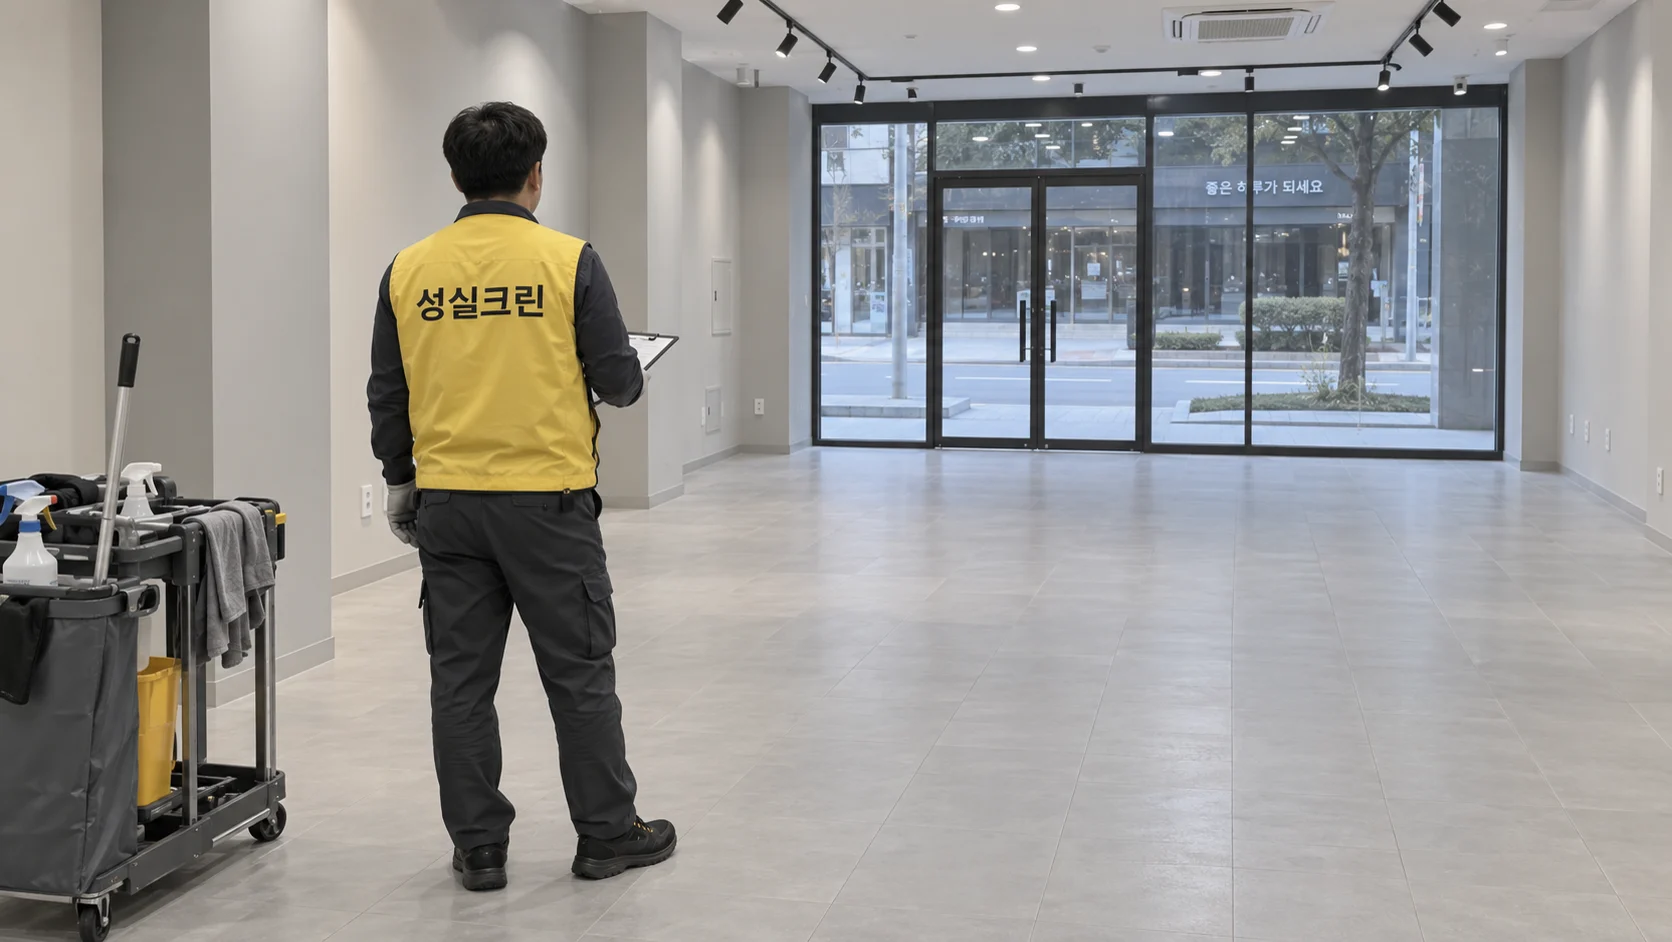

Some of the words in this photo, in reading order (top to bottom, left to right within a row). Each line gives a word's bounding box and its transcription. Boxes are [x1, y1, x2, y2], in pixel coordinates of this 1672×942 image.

[1205, 180, 1233, 196] 좋은
[1282, 179, 1324, 194] 되세요
[416, 284, 544, 321] 성실크린
